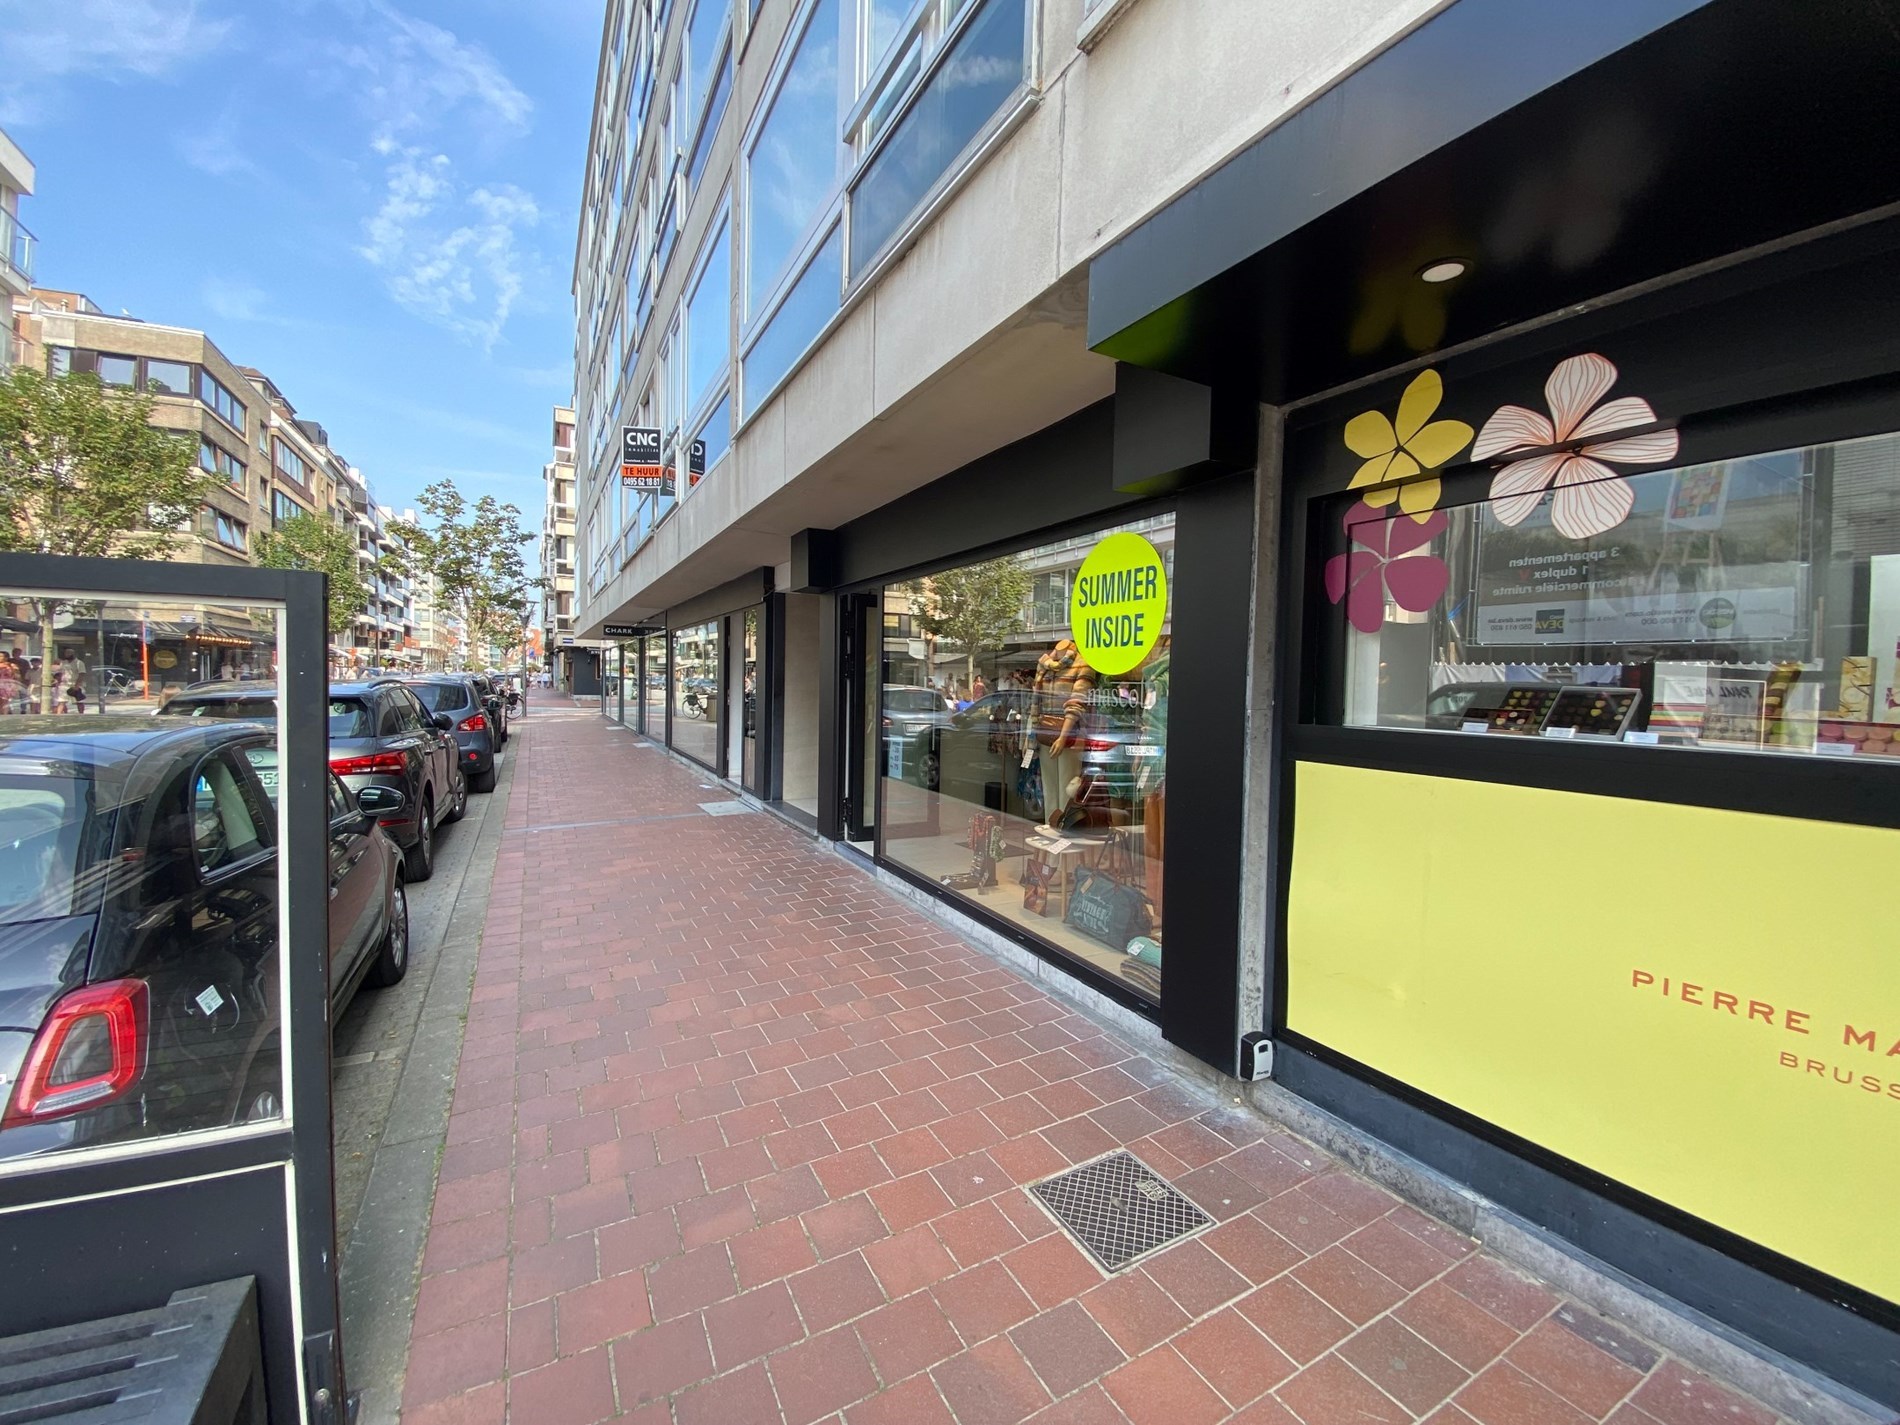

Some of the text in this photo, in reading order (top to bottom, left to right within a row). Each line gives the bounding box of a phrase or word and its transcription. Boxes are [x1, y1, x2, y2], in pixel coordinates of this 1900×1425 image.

[626, 432, 658, 446] CNC
[624, 467, 660, 476] TE HUUR
[1079, 565, 1158, 608] SUMMER
[1085, 613, 1144, 649] INSIDE
[1632, 970, 1811, 1035] PIERRE
[1779, 1051, 1900, 1101] BRUSS
